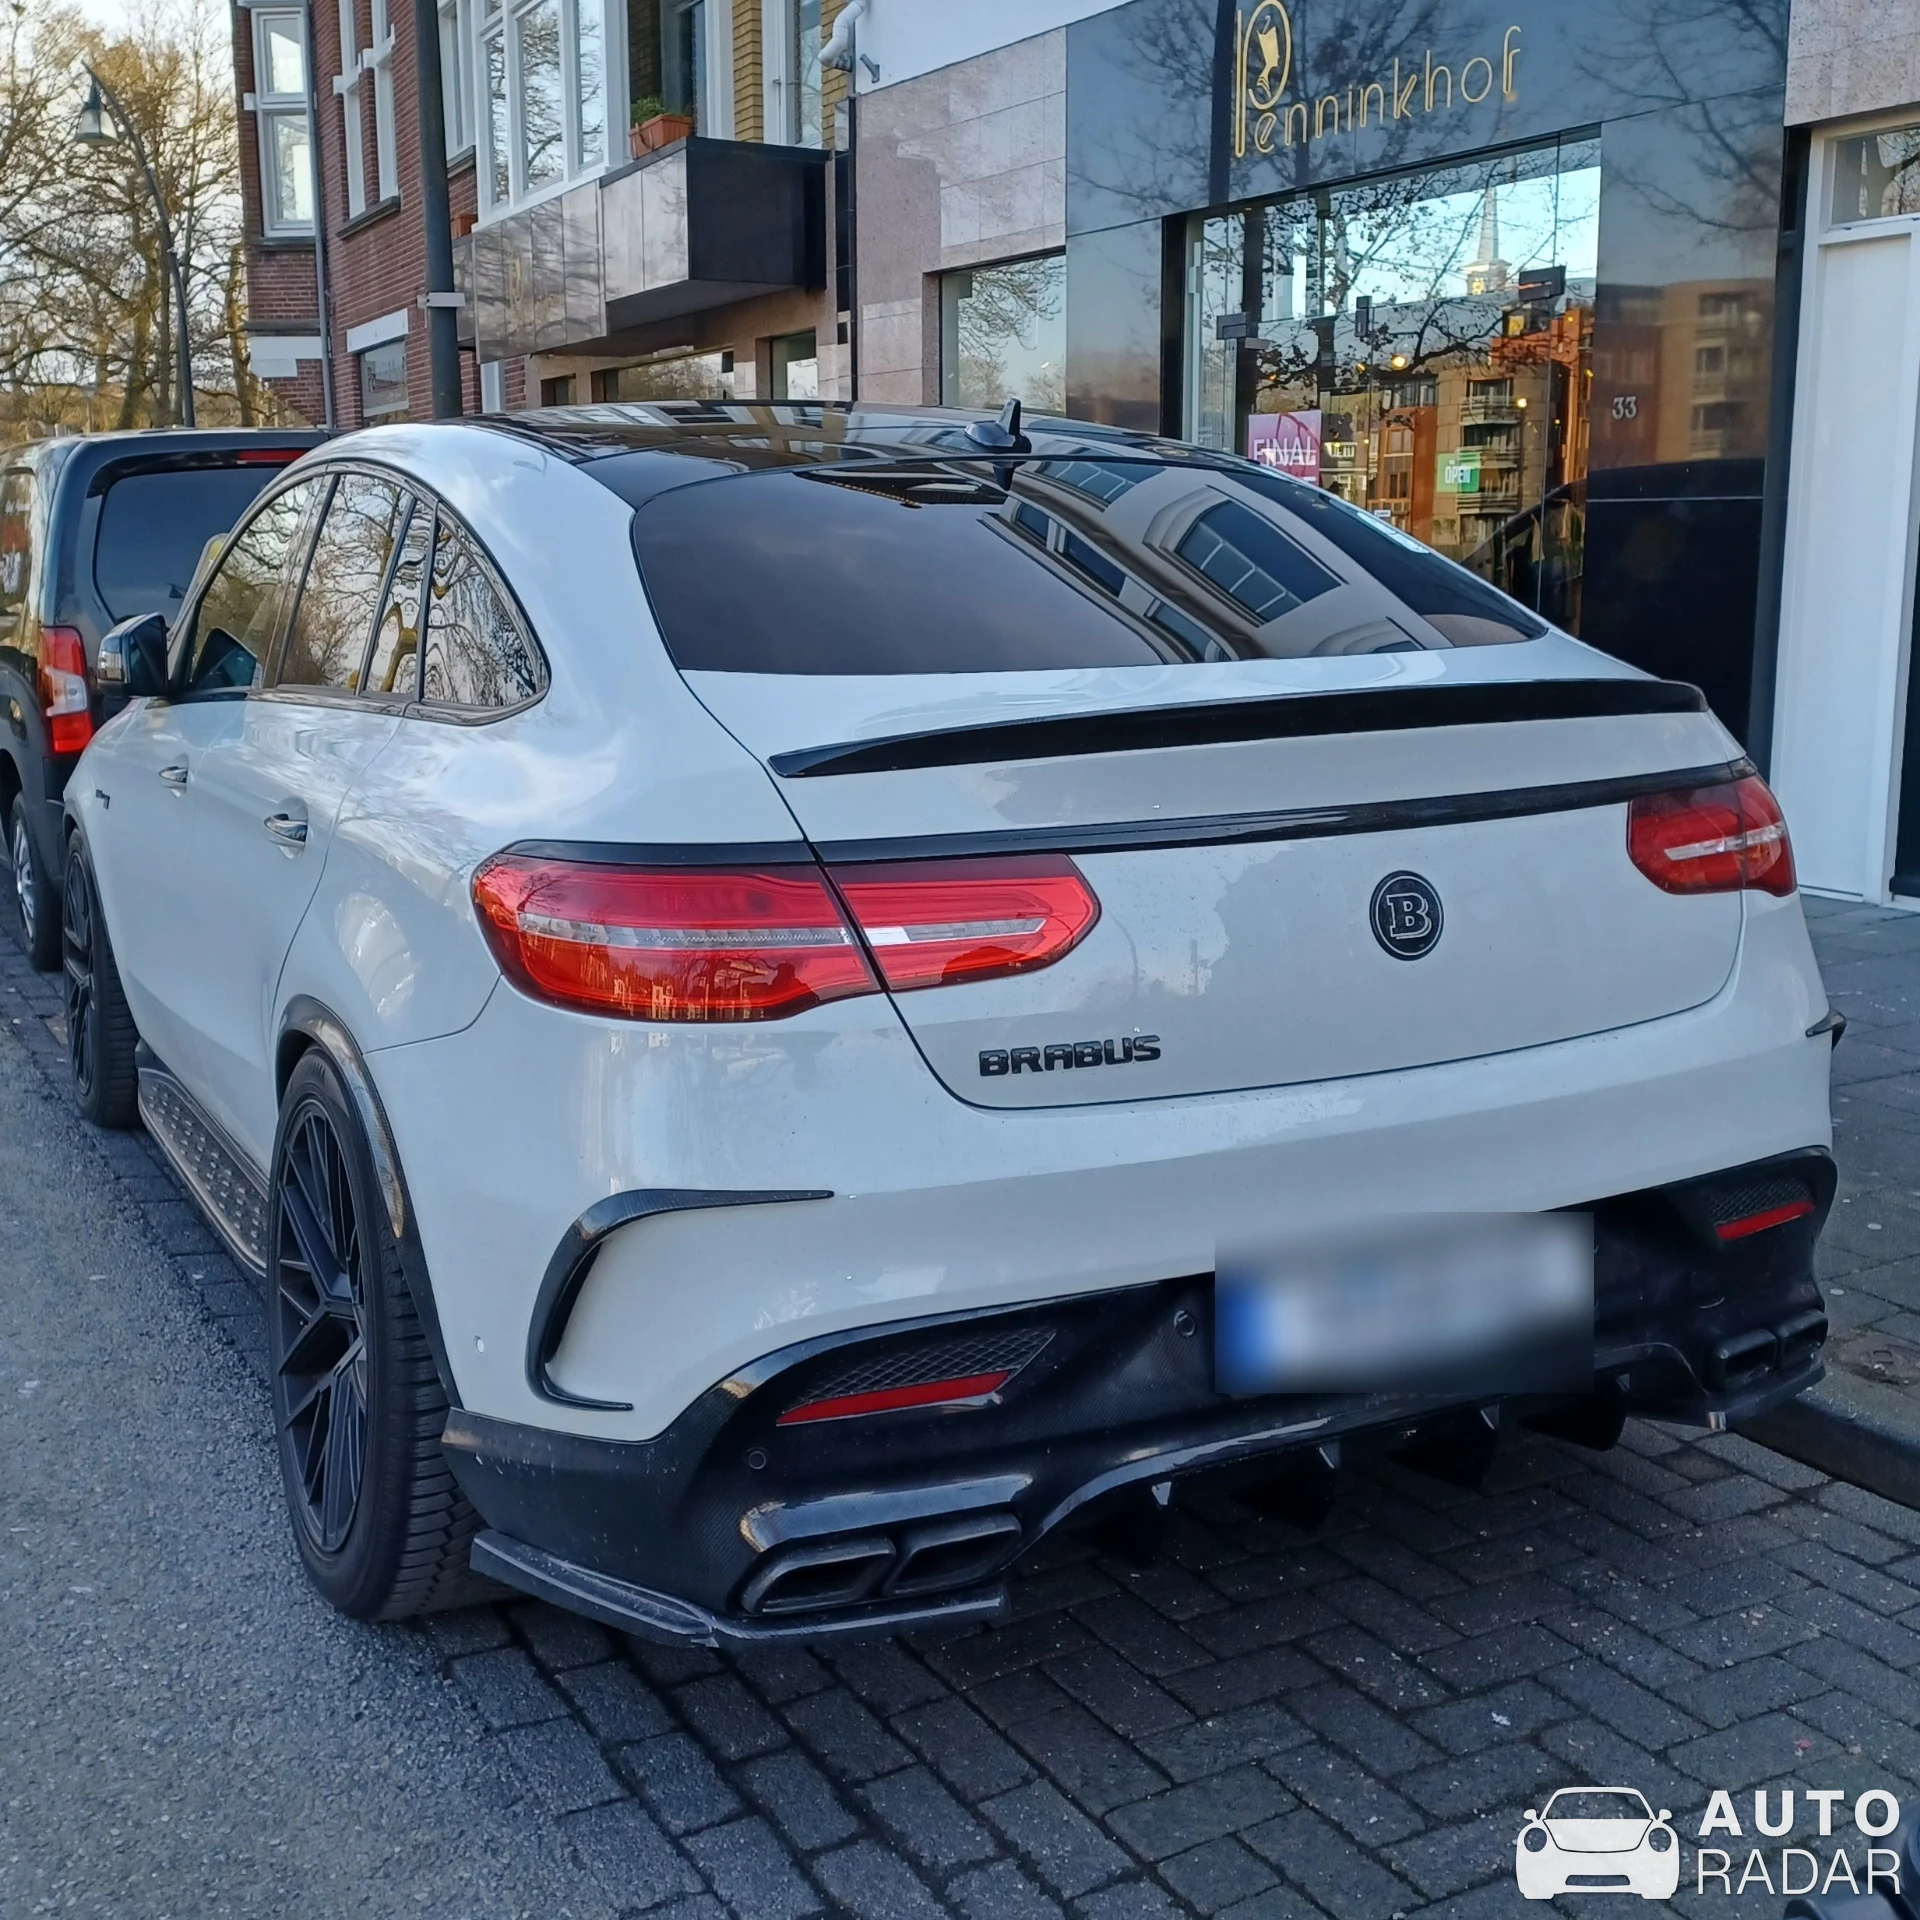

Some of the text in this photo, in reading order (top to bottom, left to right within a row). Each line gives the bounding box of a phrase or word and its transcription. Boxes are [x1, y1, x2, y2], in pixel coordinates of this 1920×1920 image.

[1235, 0, 1522, 158] Penninkhof
[1612, 395, 1637, 420] 33
[1253, 436, 1316, 466] FINAL
[1444, 465, 1471, 484] OPEN
[1386, 892, 1432, 940] B
[979, 1034, 1162, 1077] BRABUS
